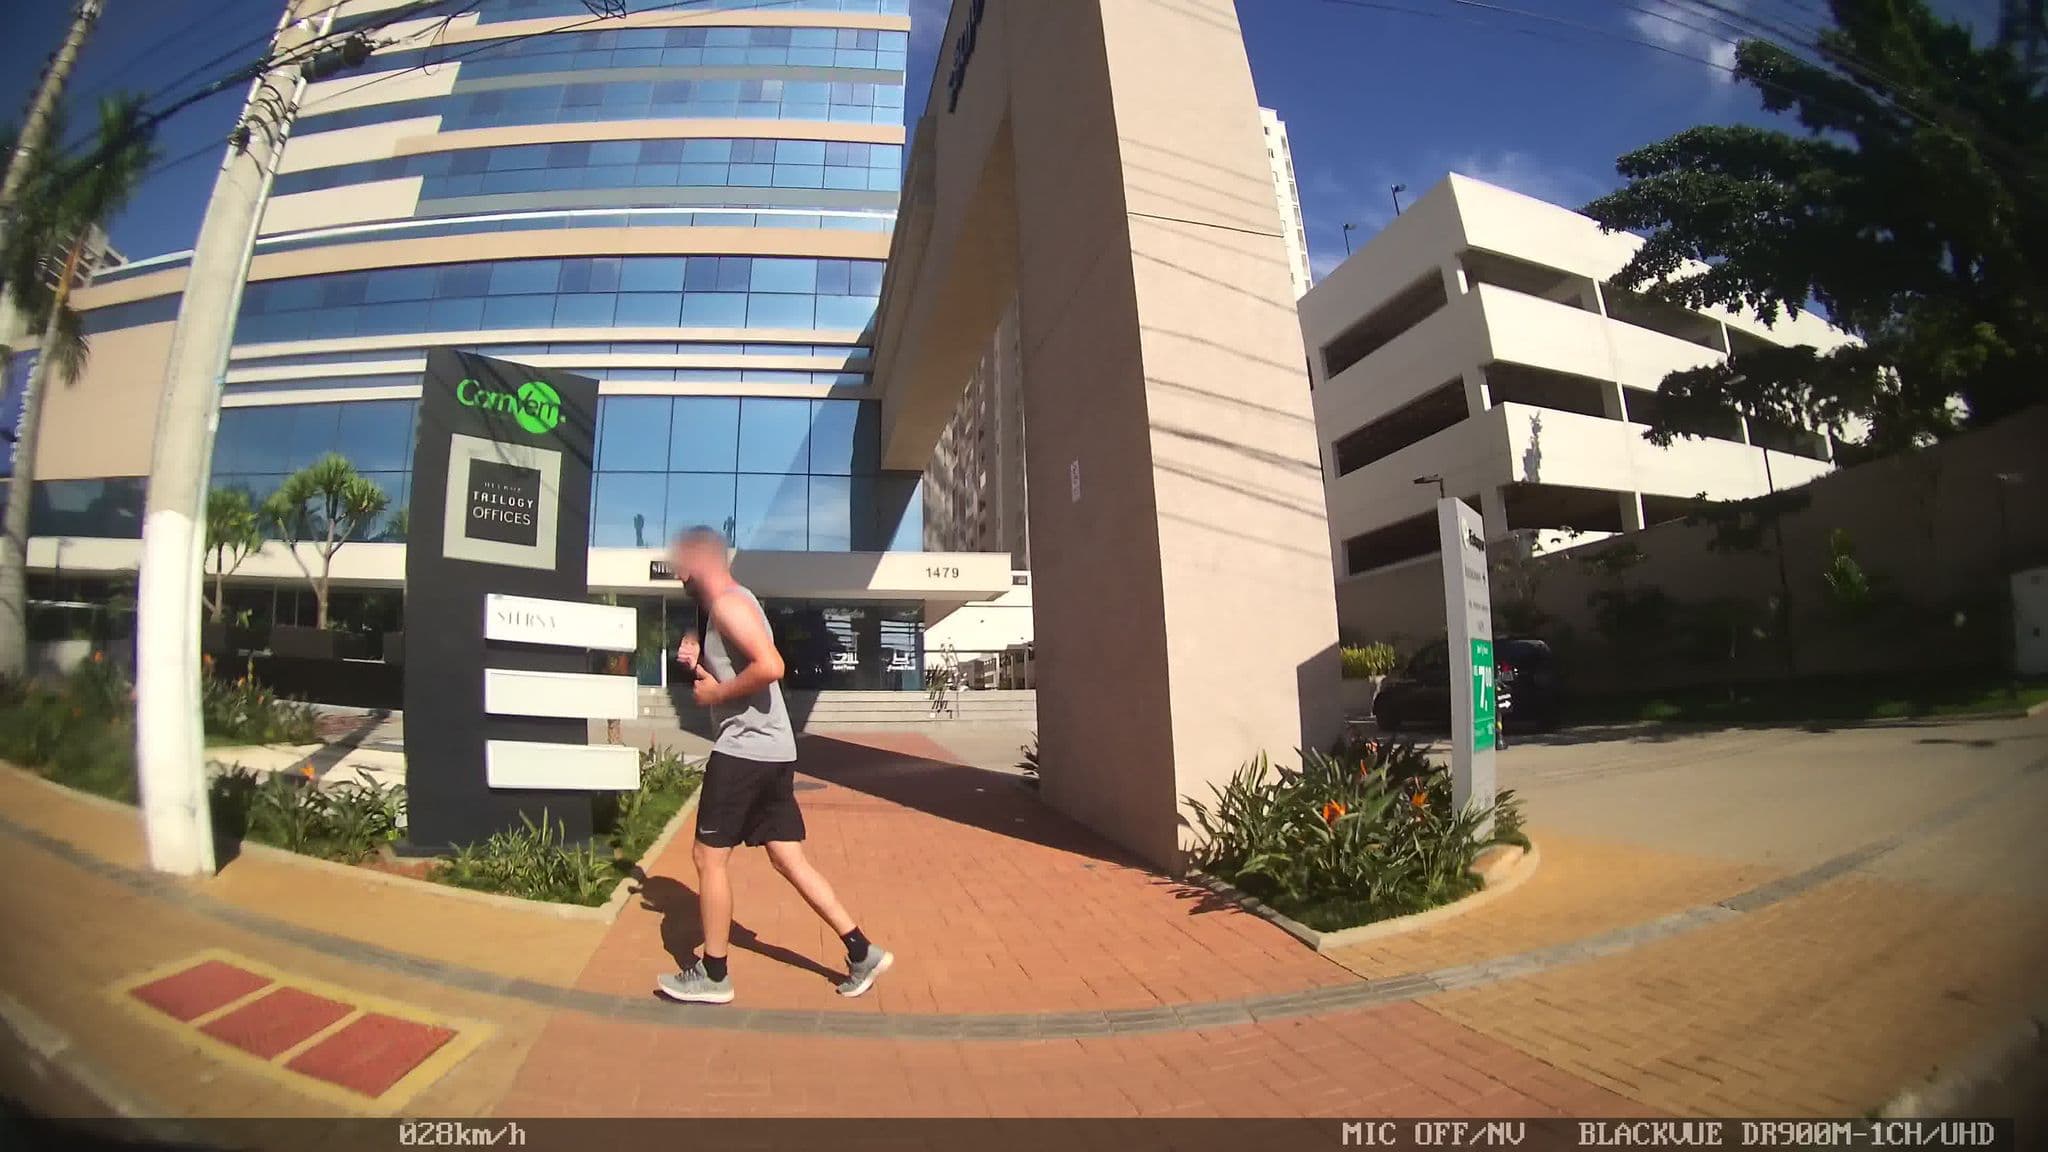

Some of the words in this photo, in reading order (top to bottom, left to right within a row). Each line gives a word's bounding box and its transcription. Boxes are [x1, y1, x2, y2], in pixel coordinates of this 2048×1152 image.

[473, 490, 534, 509] TRILOGY
[472, 506, 532, 526] OFFICES
[925, 567, 959, 579] 1479
